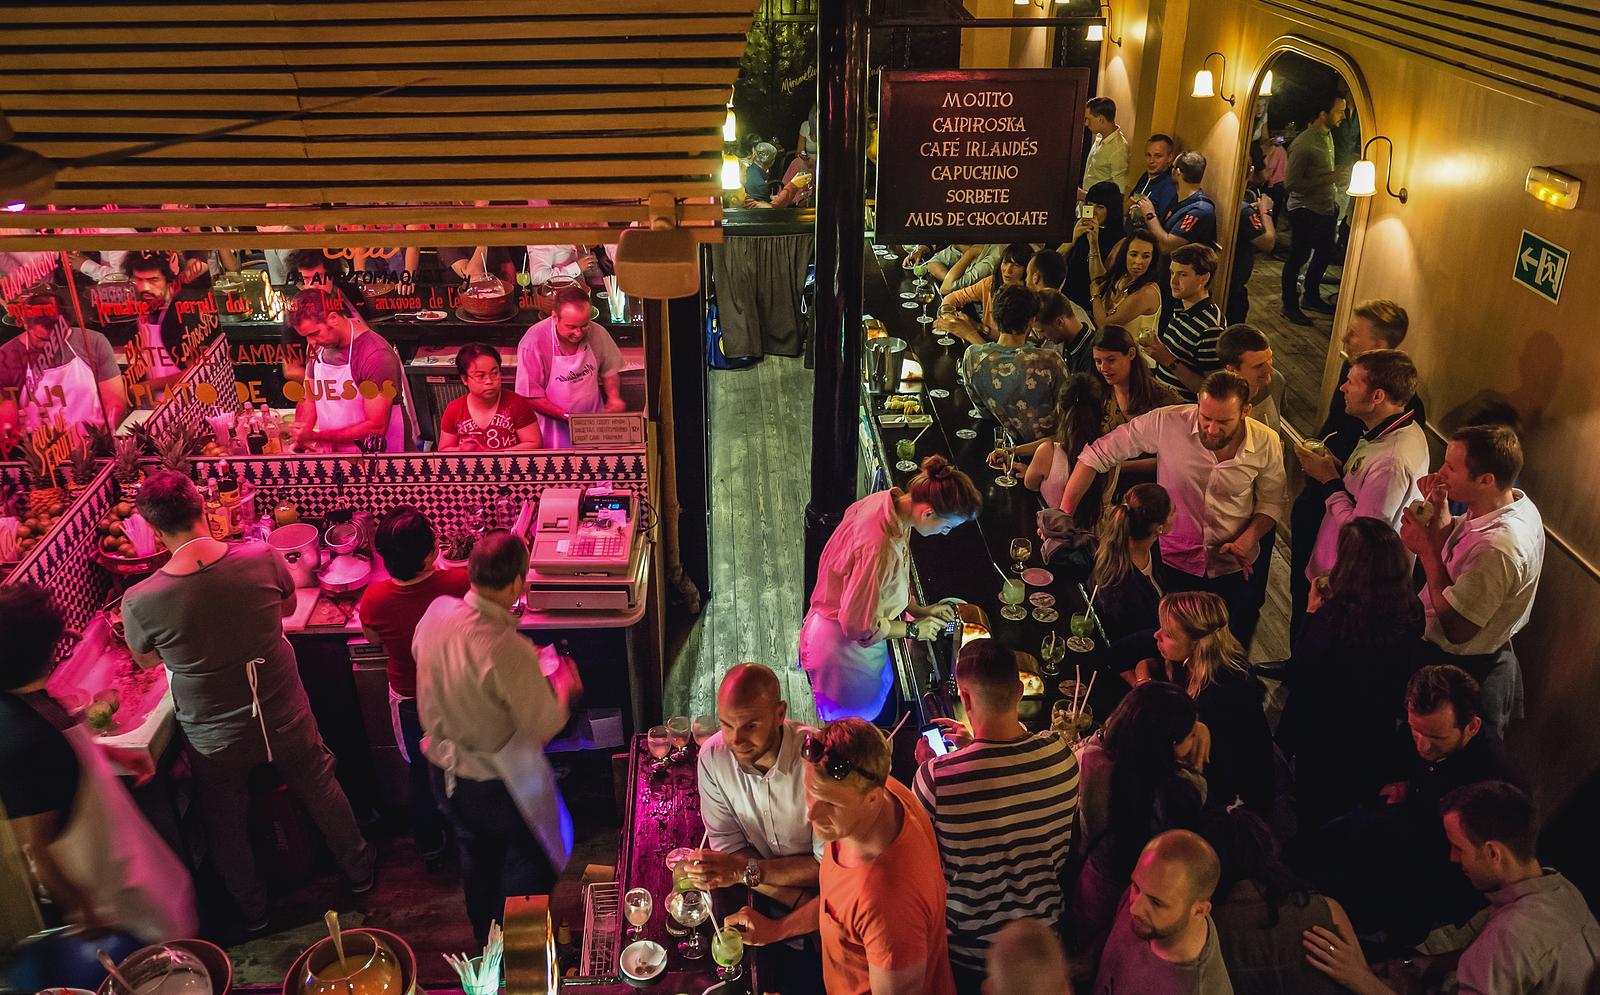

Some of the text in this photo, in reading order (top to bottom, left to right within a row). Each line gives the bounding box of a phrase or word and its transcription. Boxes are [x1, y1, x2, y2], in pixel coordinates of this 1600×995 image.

[942, 92, 1014, 108] MOJITO
[932, 117, 1026, 133] CAIPIROSKA
[920, 138, 1038, 157] CAFÉ IRLANDÉS
[931, 165, 1019, 180] CAPUCHINO
[946, 188, 1010, 204] SORBETE
[905, 211, 1048, 227] MUS DE CHOCOLATE
[429, 288, 444, 309] de
[130, 380, 397, 406] PLATO DE QUESOS
[487, 429, 500, 449] 8
